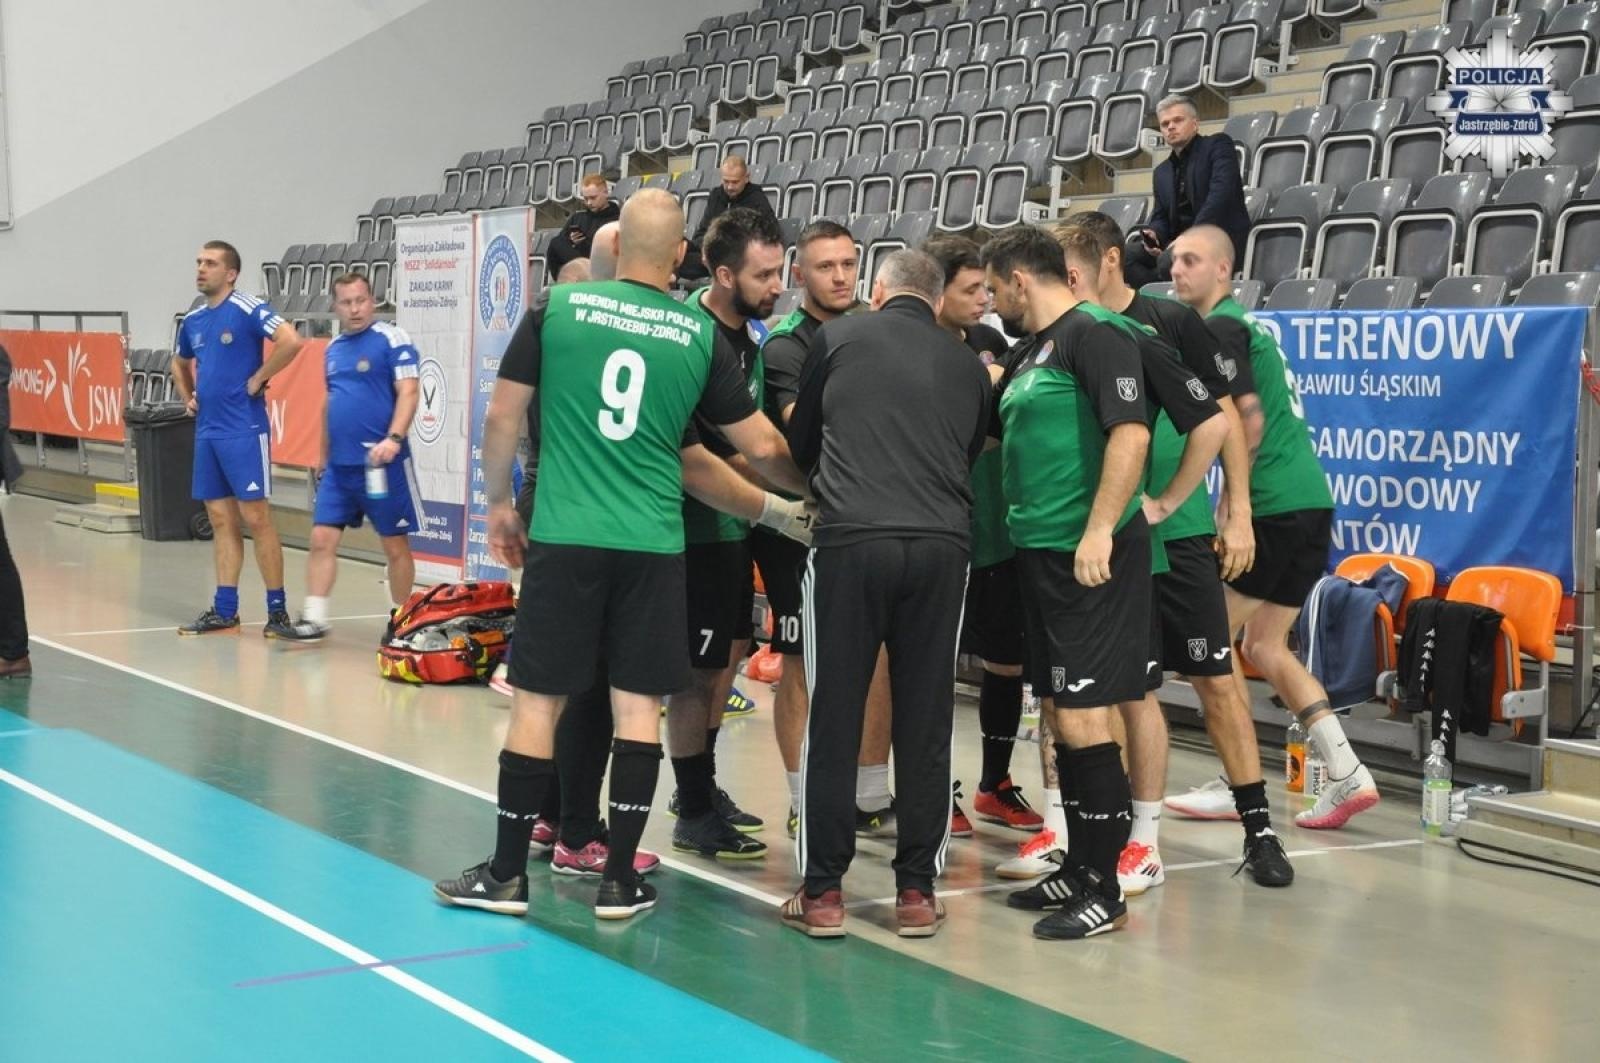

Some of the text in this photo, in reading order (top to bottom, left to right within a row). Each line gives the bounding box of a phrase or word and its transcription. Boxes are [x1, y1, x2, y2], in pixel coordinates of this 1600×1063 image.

[401, 242, 433, 256] Organizacja
[434, 280, 454, 291] KARNY
[568, 292, 618, 312] KOMENDA
[620, 302, 665, 321] MIEJSKA
[575, 308, 587, 321] W
[1290, 312, 1525, 360] TERENOWY
[598, 348, 646, 441] 9
[1360, 368, 1441, 401] ŚLĄSKIM
[88, 385, 122, 432] JSW
[1325, 472, 1482, 513] WODOWY
[699, 629, 714, 656] 7
[779, 615, 799, 643] 10
